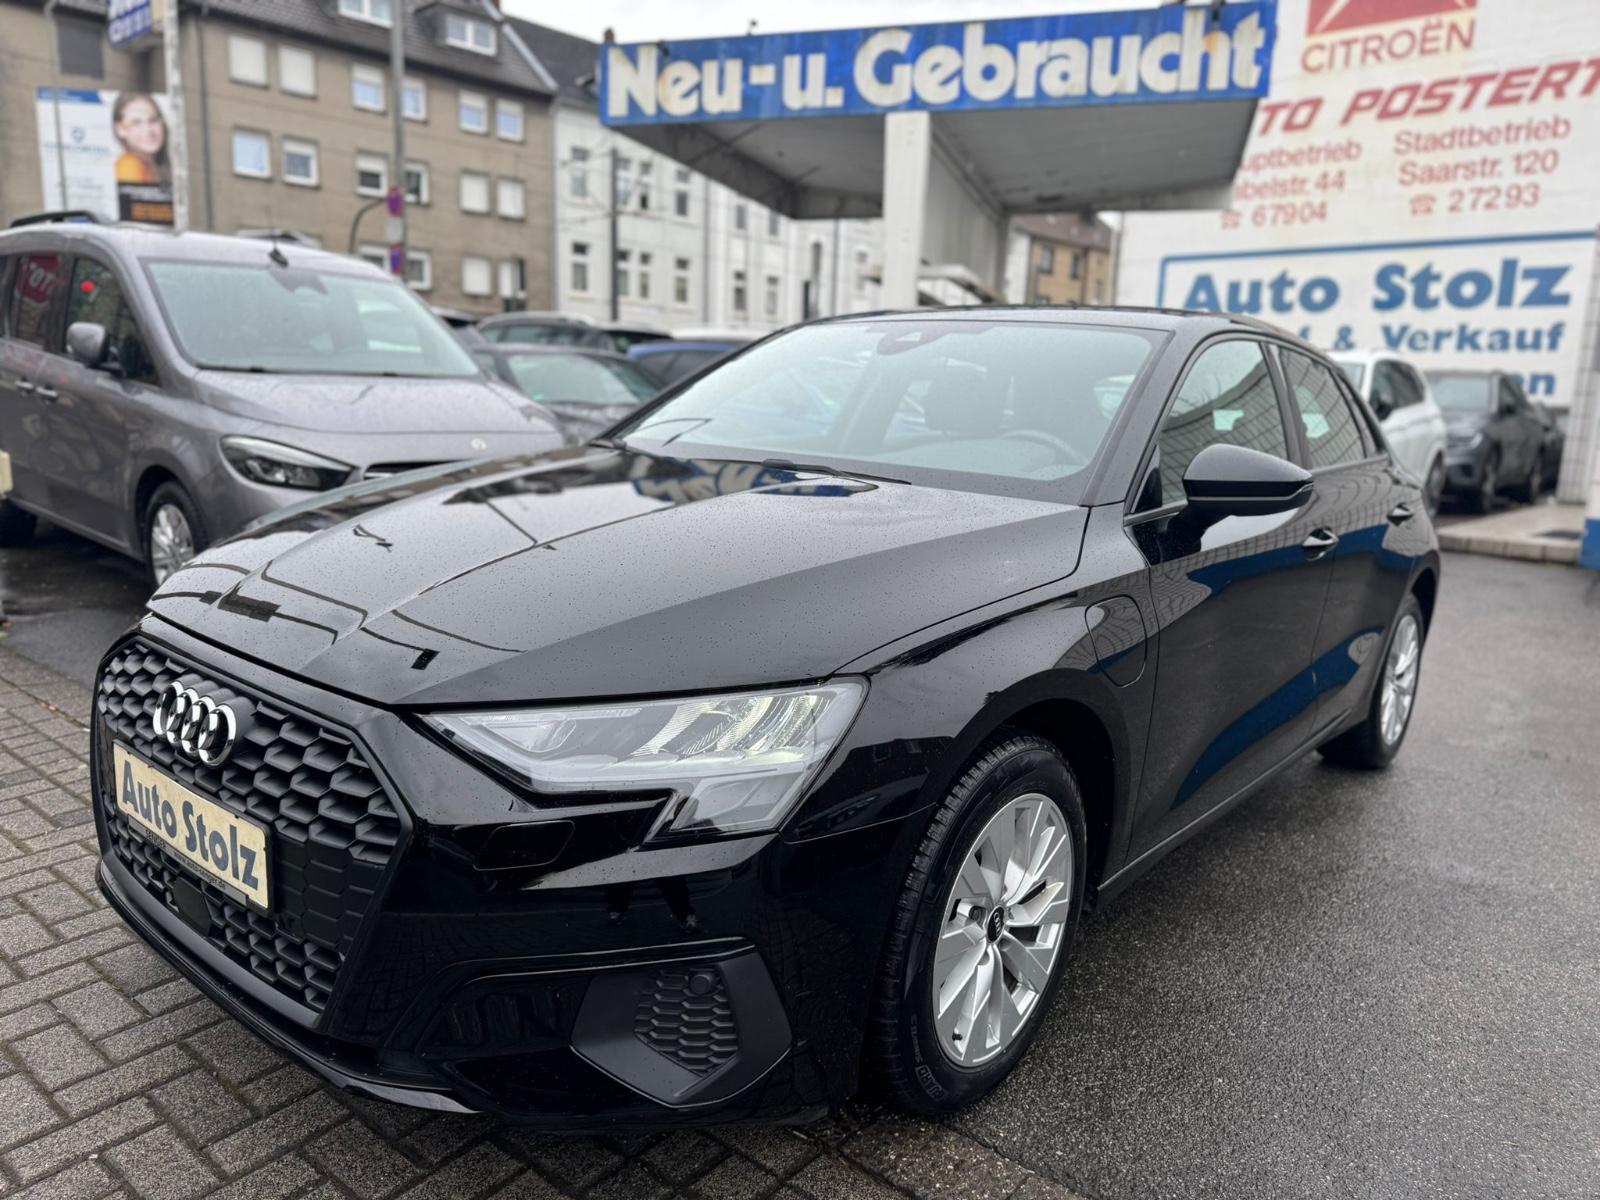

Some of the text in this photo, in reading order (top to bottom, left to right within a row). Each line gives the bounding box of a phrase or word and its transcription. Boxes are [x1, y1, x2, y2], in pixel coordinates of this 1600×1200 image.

[854, 8, 1266, 107] Gebraucht
[1301, 18, 1476, 74] CITROËN
[1394, 115, 1571, 155] Stadtbetrieb
[1315, 170, 1346, 192] 44
[1398, 148, 1560, 186] Saarstr. 120
[1182, 257, 1574, 315] Auto Stolz
[1333, 325, 1356, 351] &
[1381, 321, 1566, 352] Verkauf
[123, 760, 259, 892] Auto Stolz
